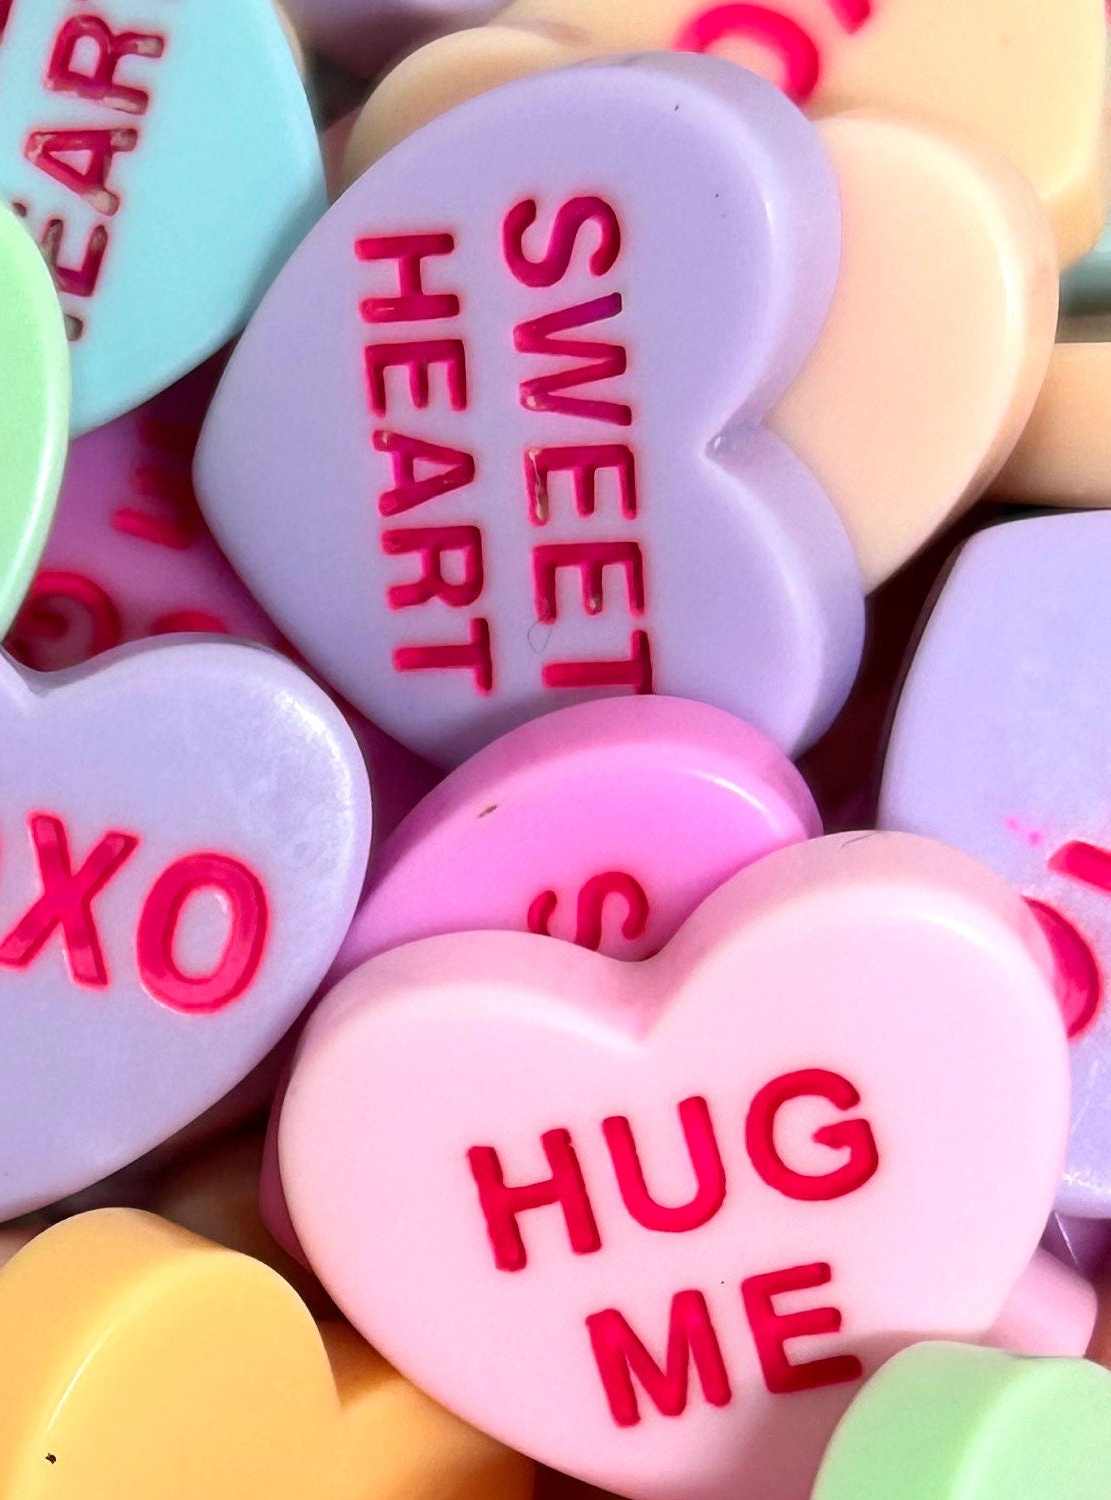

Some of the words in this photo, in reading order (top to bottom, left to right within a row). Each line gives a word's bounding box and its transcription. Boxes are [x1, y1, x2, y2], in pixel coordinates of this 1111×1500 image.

[353, 231, 495, 696] HEART
[501, 194, 655, 694] SWEET
[466, 1068, 879, 1273] HUG
[585, 1262, 864, 1428] ME
